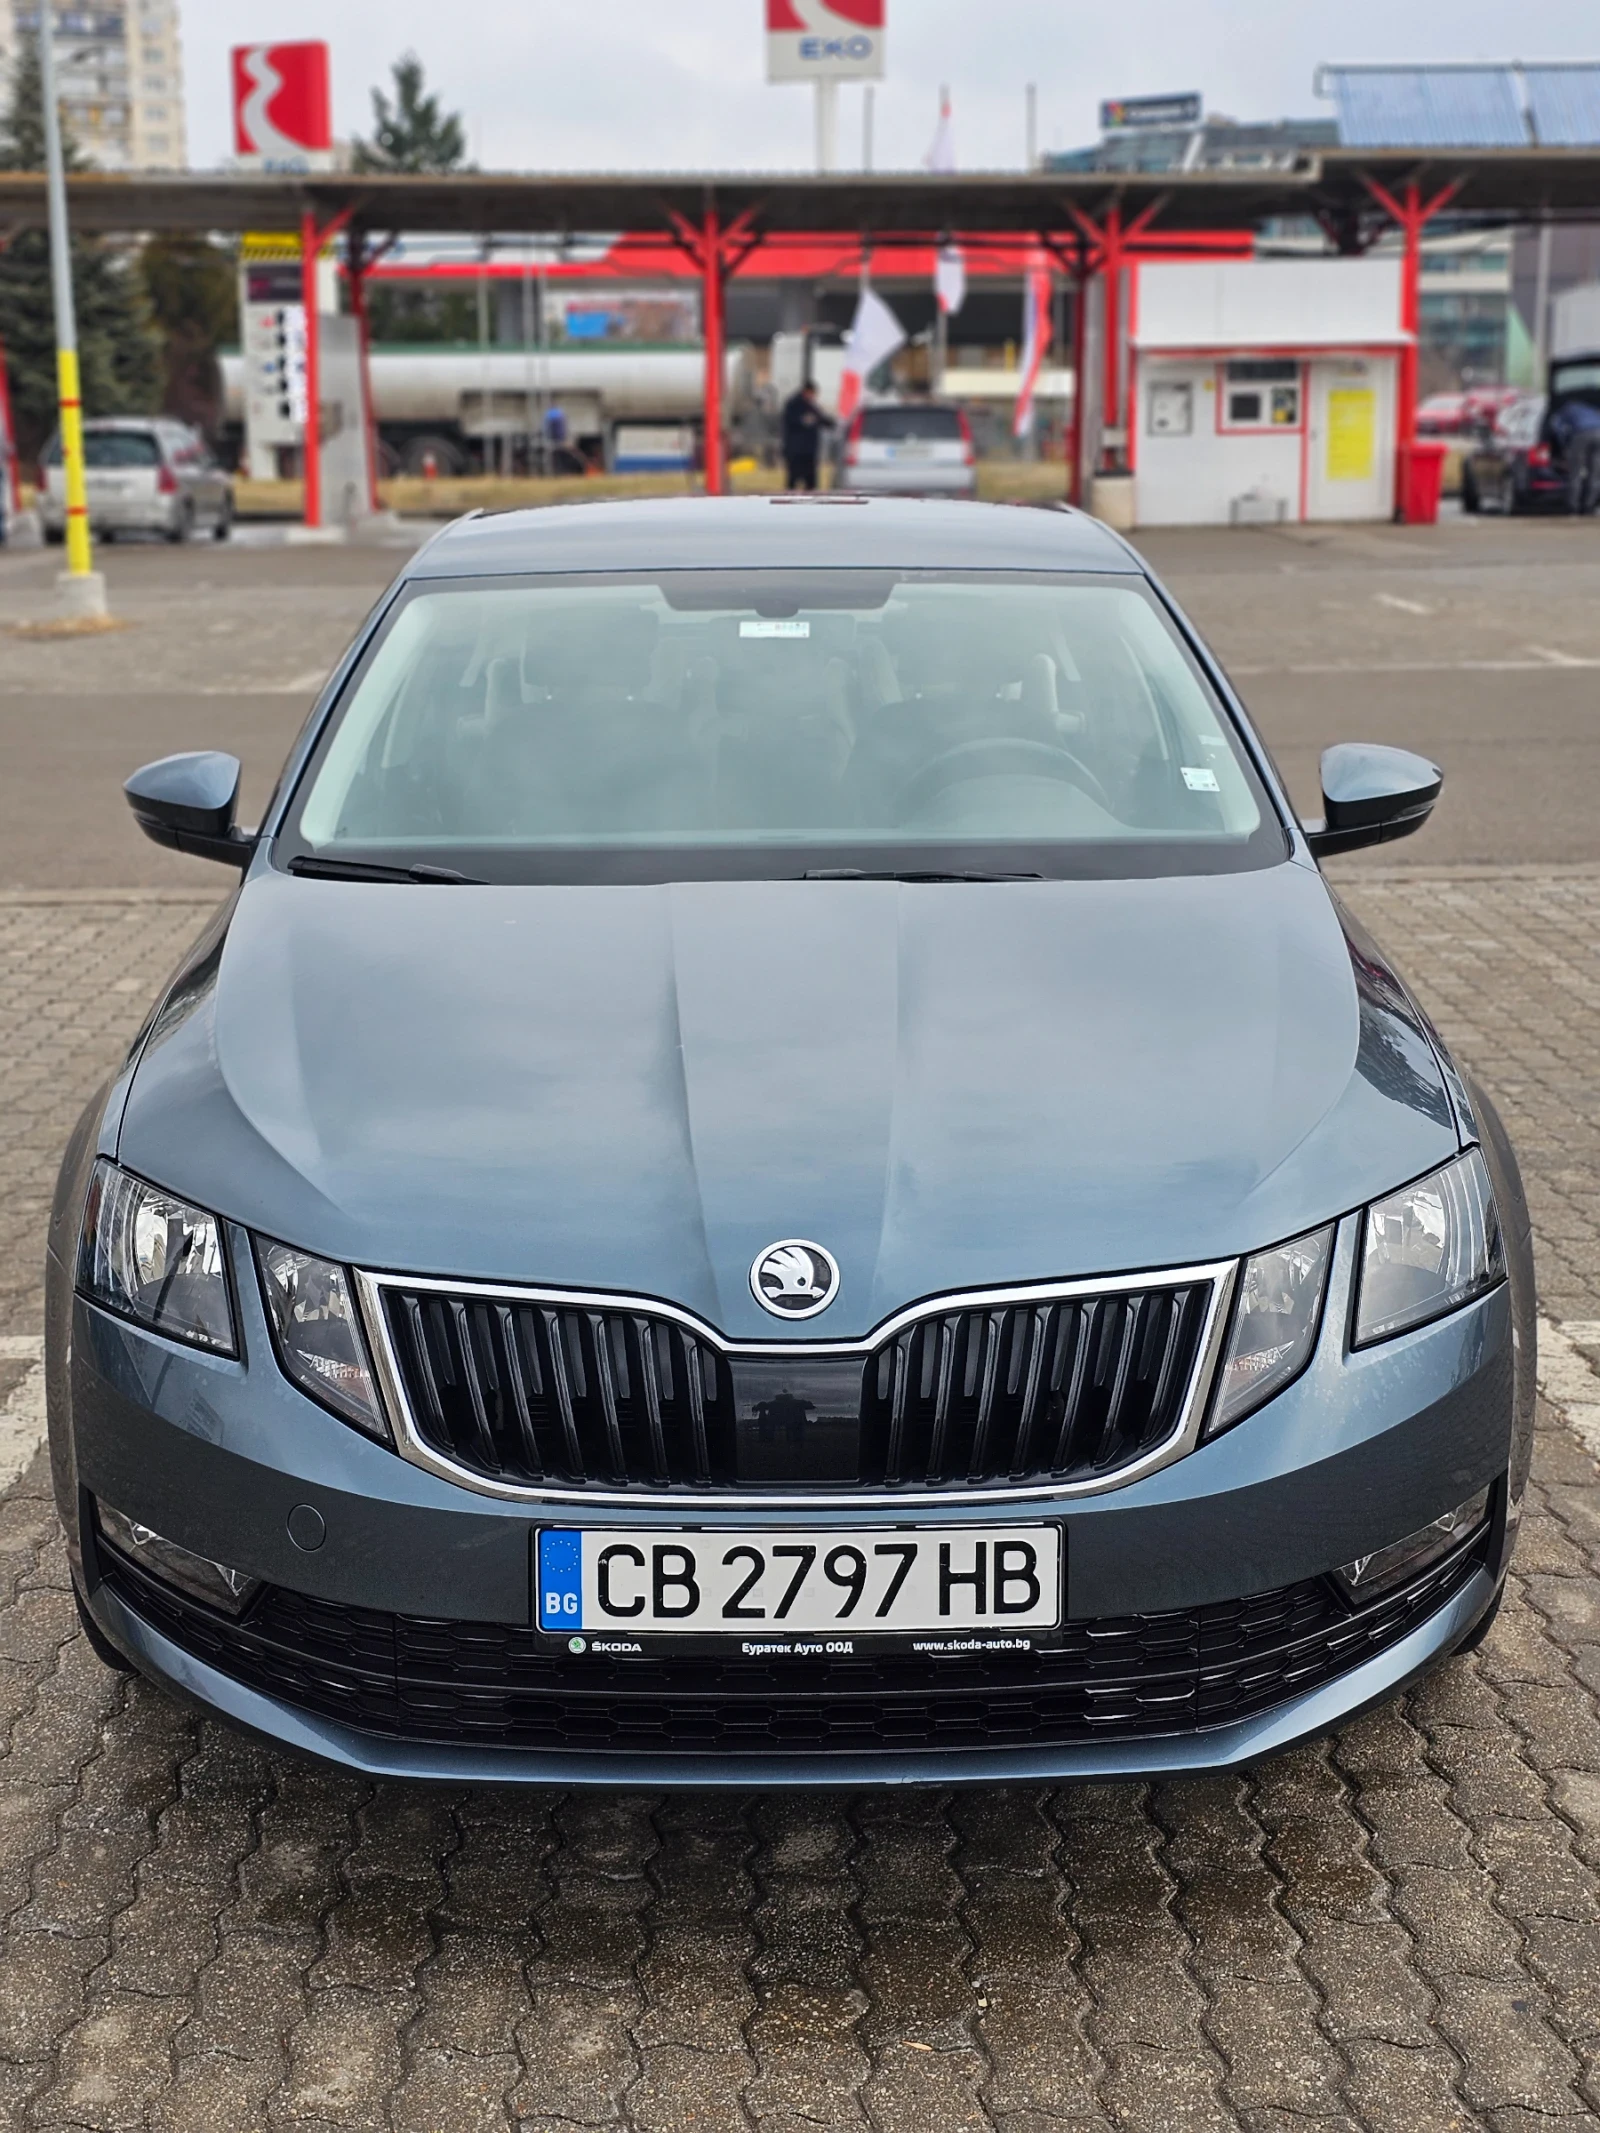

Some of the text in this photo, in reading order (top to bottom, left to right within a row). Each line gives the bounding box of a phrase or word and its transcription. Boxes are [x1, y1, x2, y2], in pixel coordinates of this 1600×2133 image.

[799, 35, 873, 60] EKO
[597, 1540, 1041, 1619] CB 2797 HB
[545, 1592, 578, 1615] BG
[591, 1640, 643, 1652] ŠKODA
[741, 1641, 854, 1656] Еуратек Ауто ООД
[912, 1638, 1031, 1651] www.skoda-auto.bg
